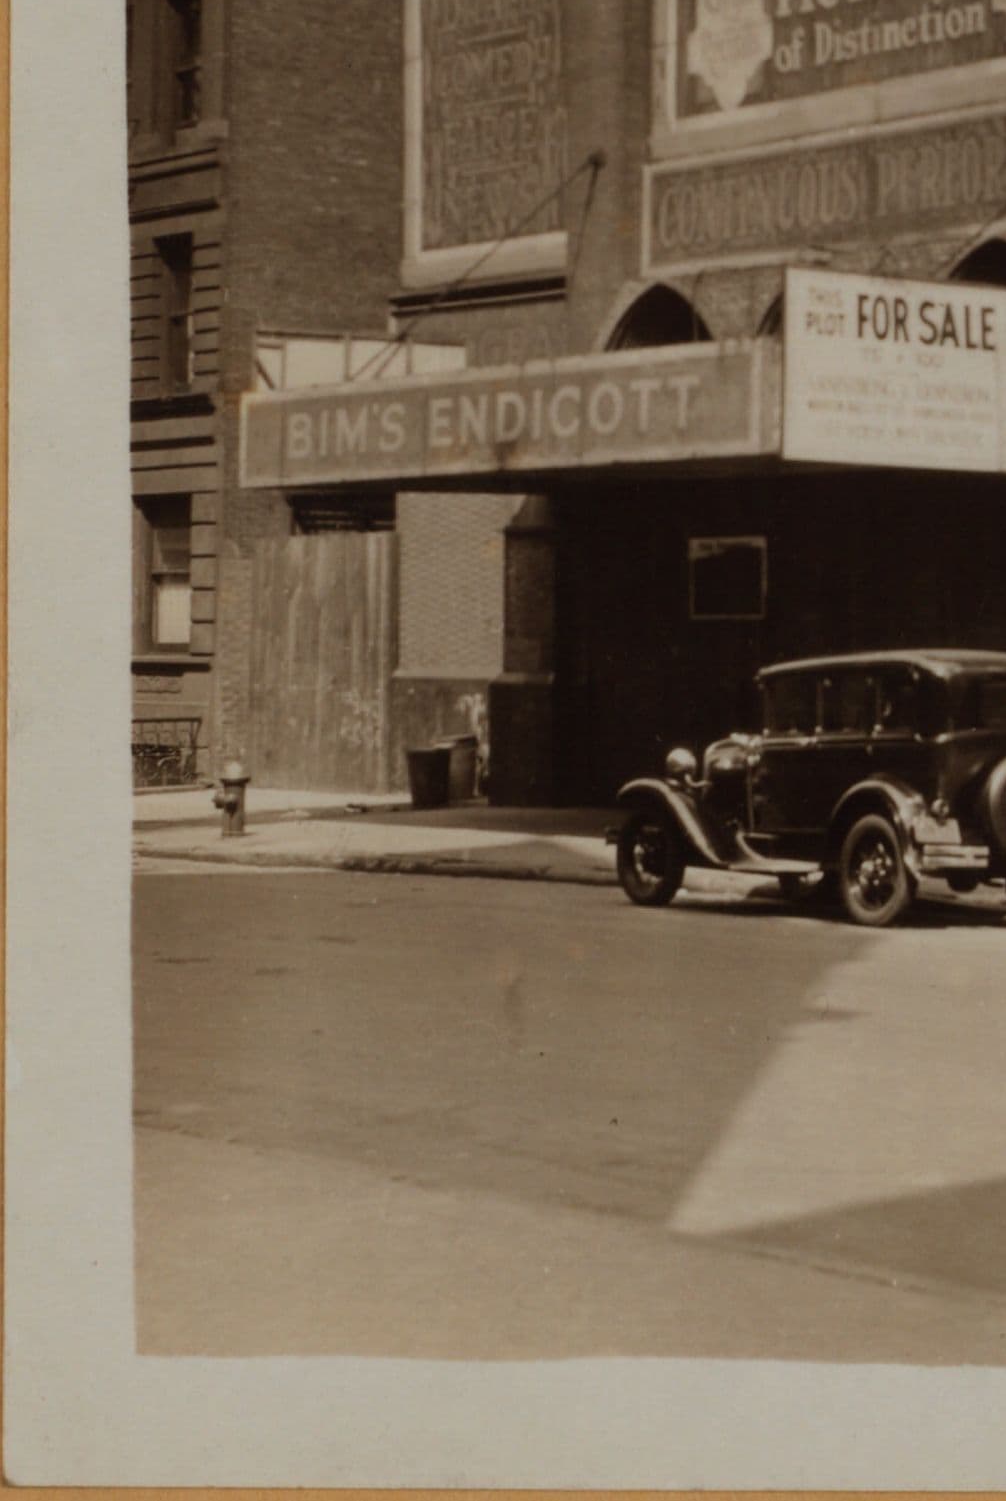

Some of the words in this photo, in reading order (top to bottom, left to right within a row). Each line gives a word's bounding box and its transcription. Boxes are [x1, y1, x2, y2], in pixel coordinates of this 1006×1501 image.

[773, 25, 805, 74] of
[813, 0, 987, 67] Distinction
[658, 155, 860, 248] CONTINUOUS
[856, 294, 910, 343] FOR
[919, 301, 996, 352] SALE
[286, 402, 407, 459] BIM'S
[428, 374, 700, 448] ENDICOTT
